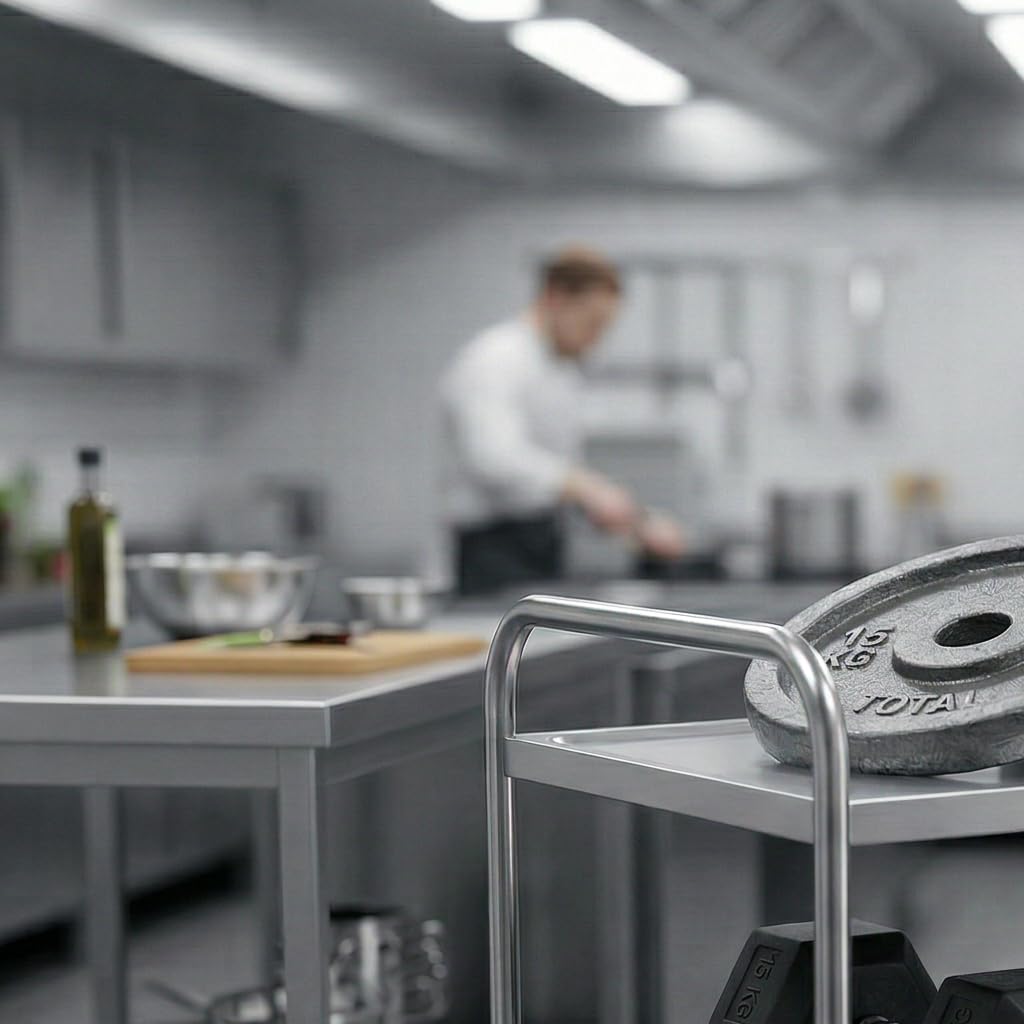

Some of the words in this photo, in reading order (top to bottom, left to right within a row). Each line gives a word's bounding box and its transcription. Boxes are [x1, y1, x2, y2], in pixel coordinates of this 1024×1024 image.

[845, 626, 895, 648] 15
[853, 689, 977, 716] TOTAL
[755, 952, 776, 980] 15
[737, 986, 761, 1019] KG
